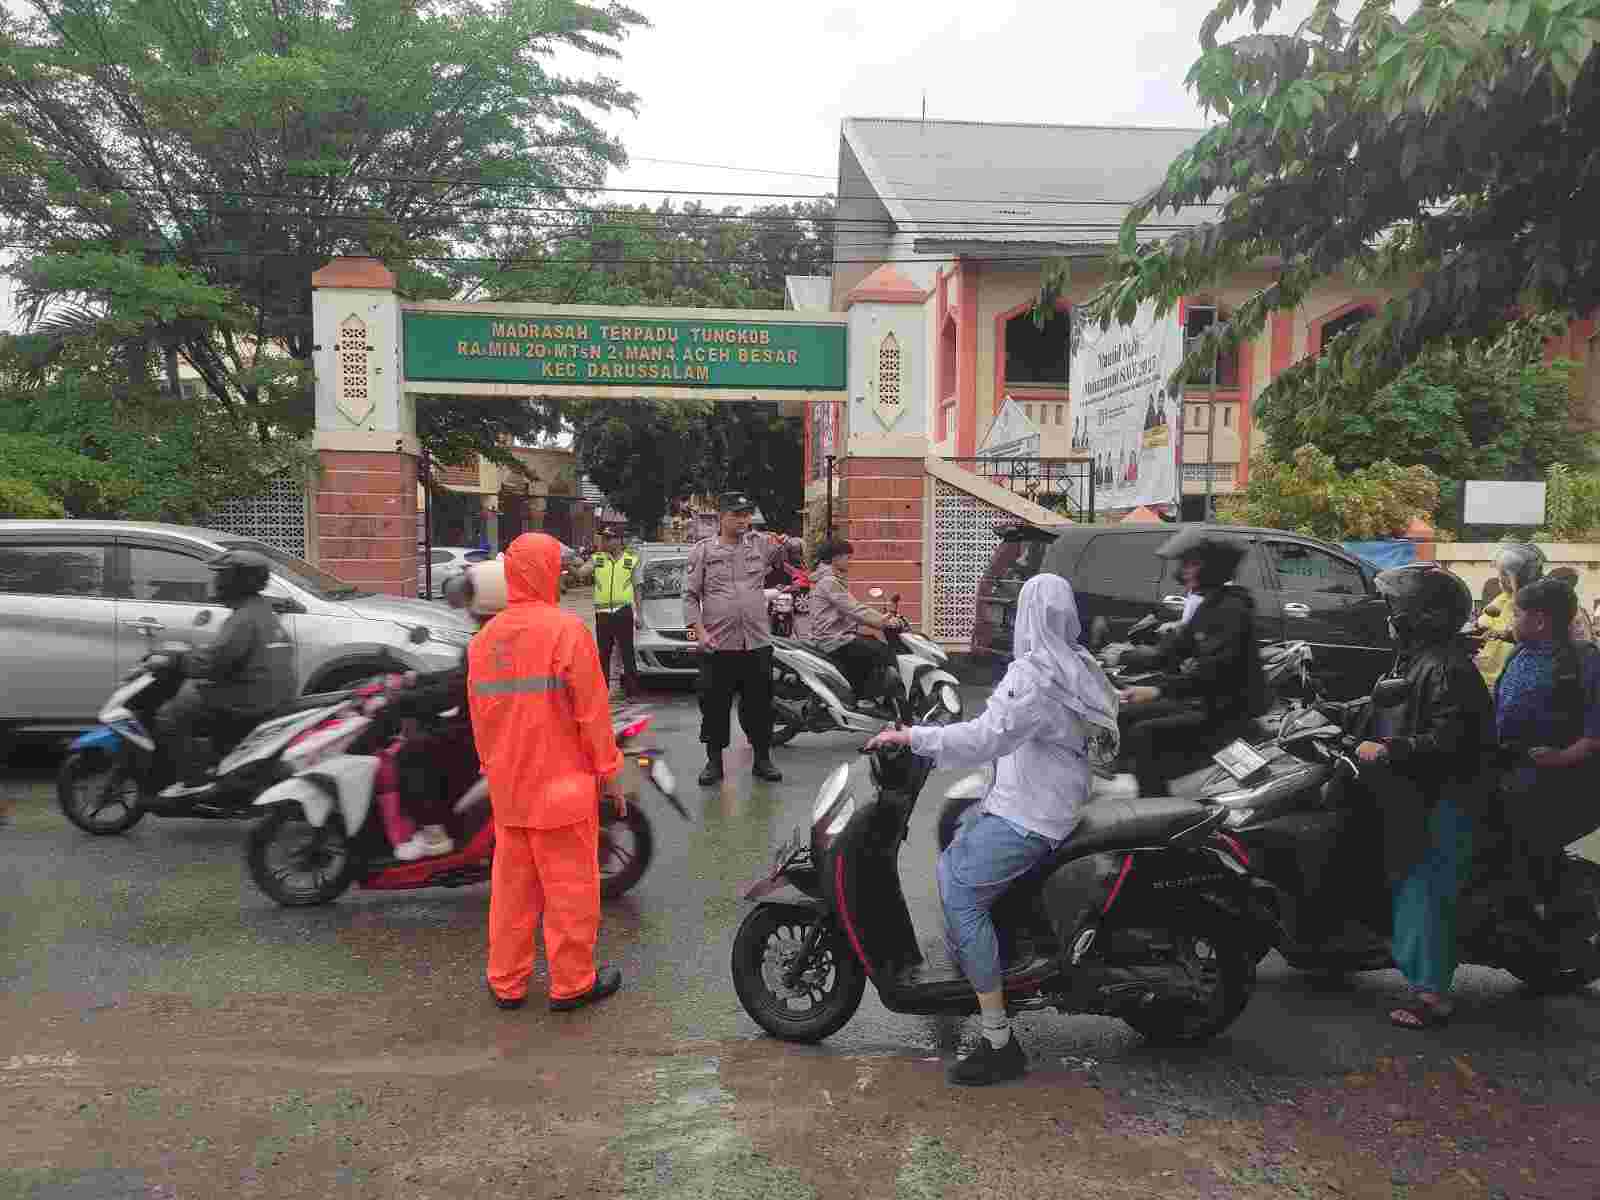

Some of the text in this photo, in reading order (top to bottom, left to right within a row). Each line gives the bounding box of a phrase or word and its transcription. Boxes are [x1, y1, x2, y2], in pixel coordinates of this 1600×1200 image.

[491, 323, 587, 339] MADRASAH
[600, 325, 679, 341] TERPADU
[683, 347, 730, 362] ACEH
[738, 349, 798, 364] BESAR
[587, 363, 709, 380] DARUSSALAM
